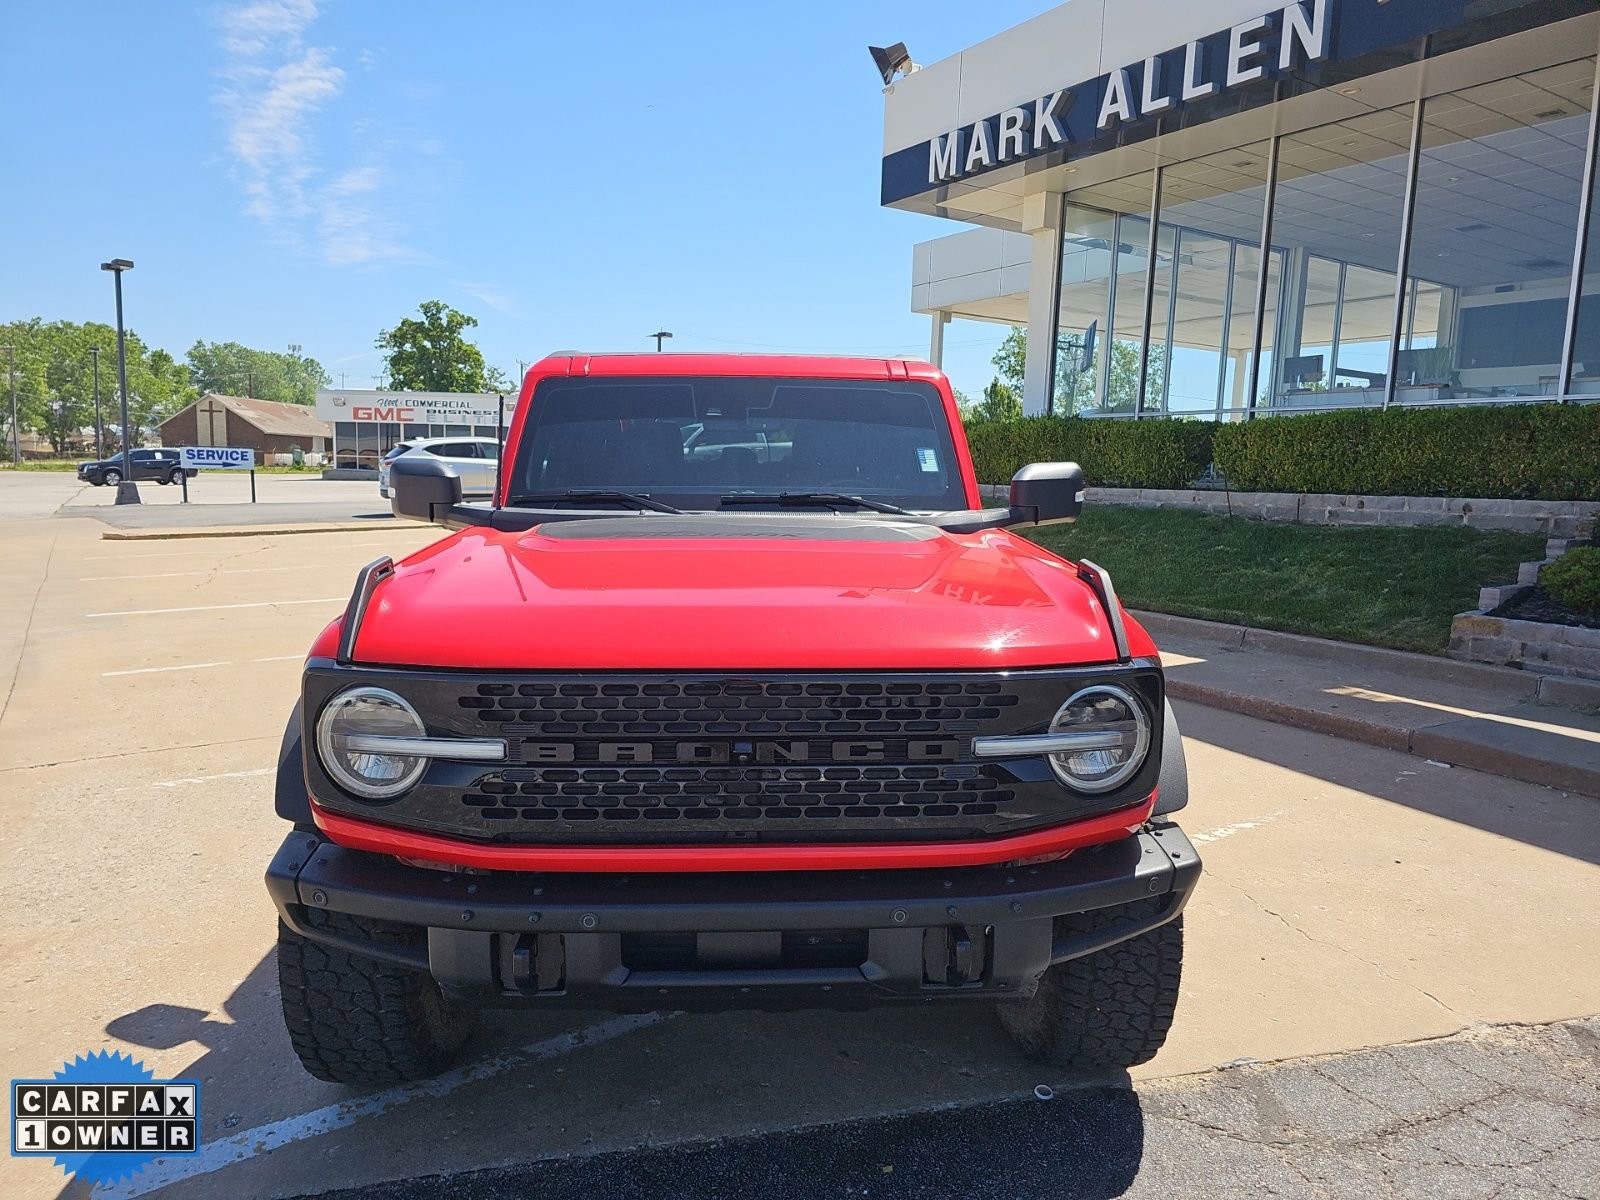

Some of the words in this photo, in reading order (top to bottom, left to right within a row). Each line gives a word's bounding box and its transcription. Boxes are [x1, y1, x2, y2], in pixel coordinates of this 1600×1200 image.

[928, 90, 1071, 184] MARK
[1096, 0, 1330, 129] ALLEN
[405, 399, 473, 409] COMMERCIAL
[352, 407, 415, 422] GMC
[186, 448, 249, 462] SERVICE
[520, 741, 960, 763] BRONCO
